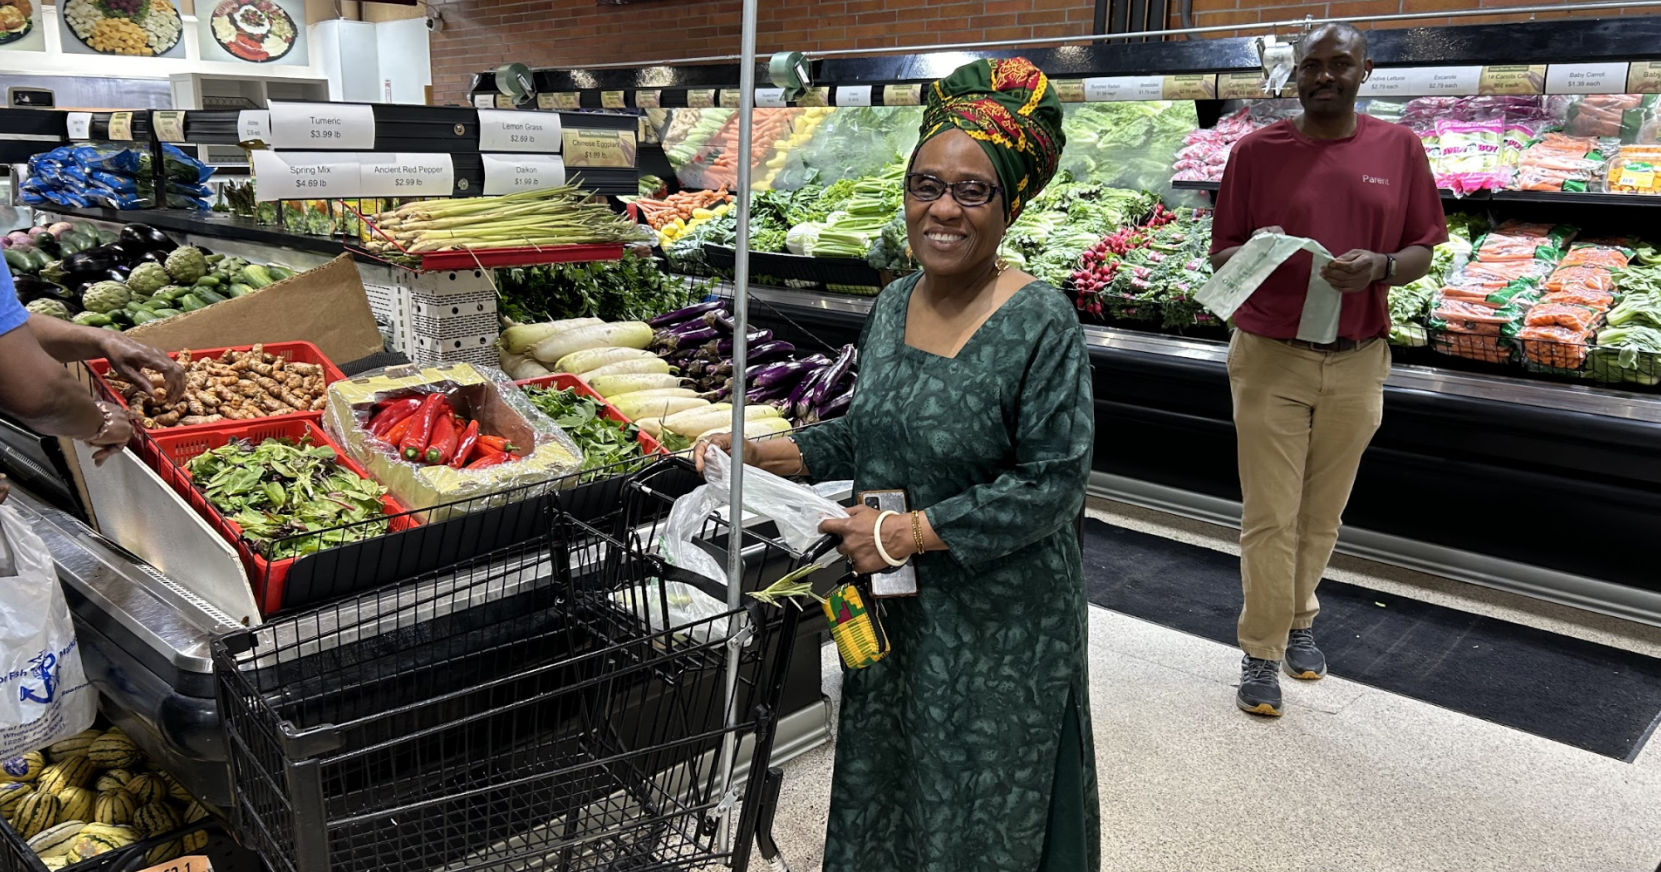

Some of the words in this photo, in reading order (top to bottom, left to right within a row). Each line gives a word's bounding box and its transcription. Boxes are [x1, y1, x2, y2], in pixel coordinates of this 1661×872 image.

[310, 116, 341, 124] Tumeric
[310, 130, 332, 138] $3.99
[597, 140, 620, 148] Eggplant
[1477, 144, 1499, 153] BOY
[290, 166, 316, 175] Spring
[1362, 174, 1390, 185] Parent
[9, 670, 27, 680] Fish
